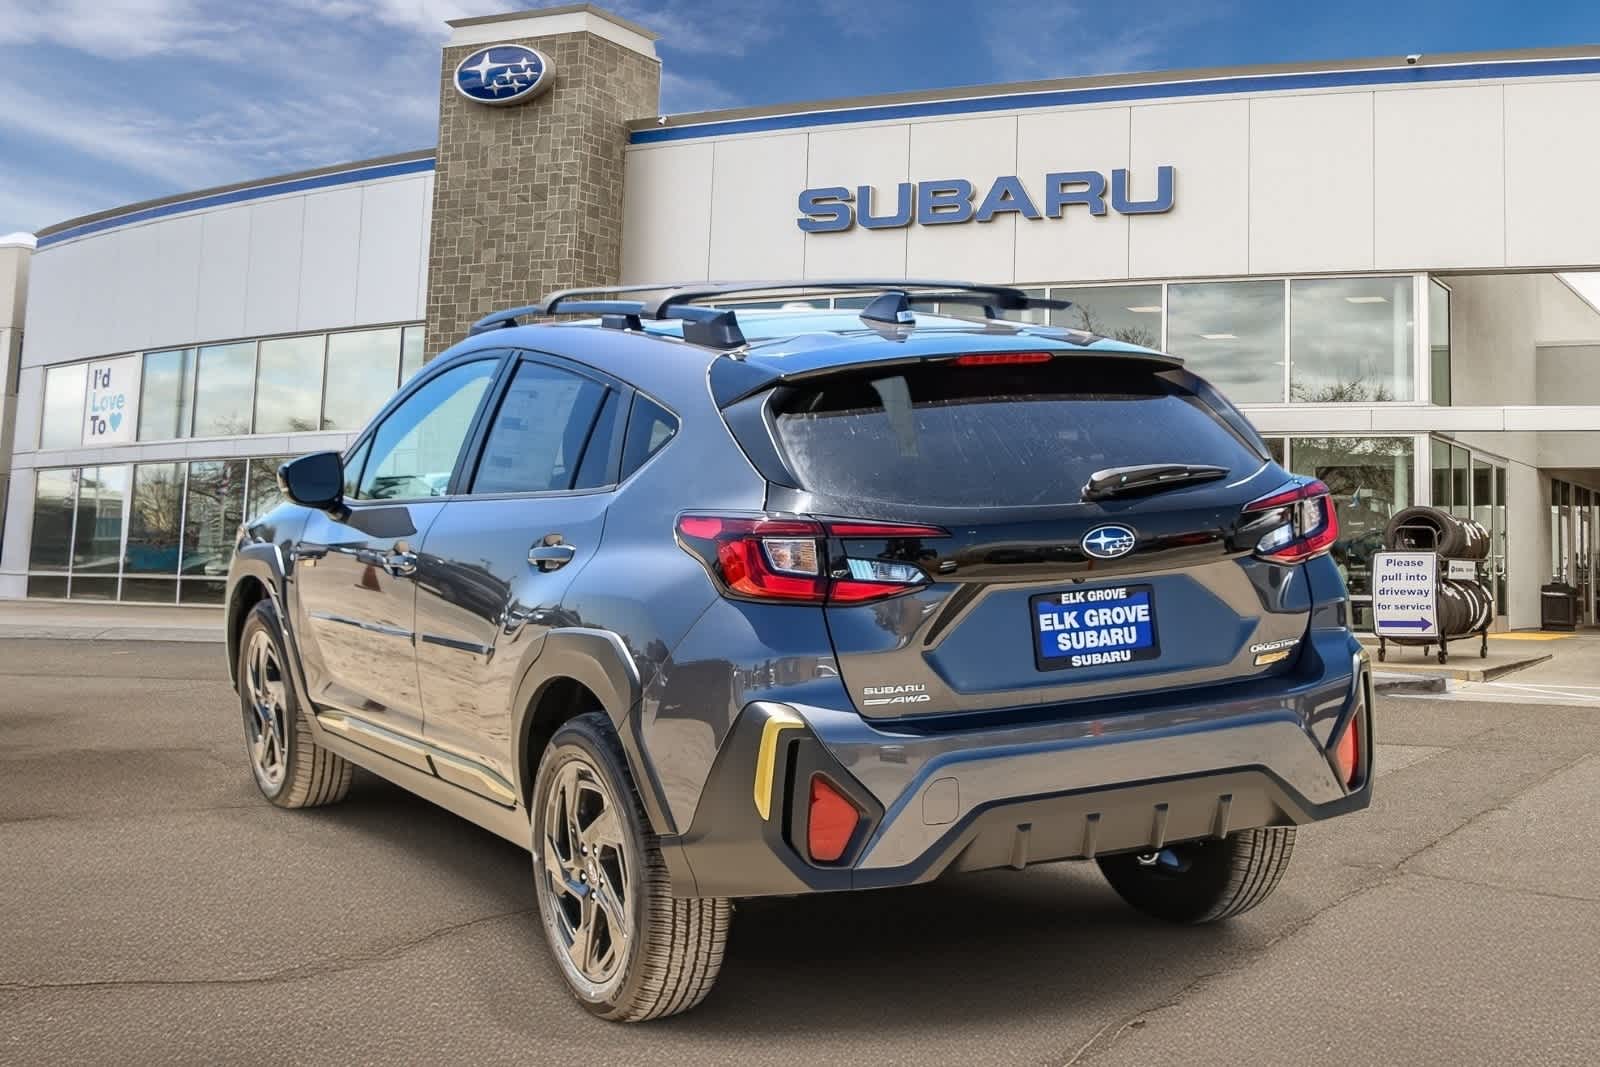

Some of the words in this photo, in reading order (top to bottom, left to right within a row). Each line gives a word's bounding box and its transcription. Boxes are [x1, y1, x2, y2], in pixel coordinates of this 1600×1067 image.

[796, 165, 1176, 235] SUBARU
[93, 368, 112, 390] I'd
[91, 391, 125, 413] Love
[90, 415, 106, 436] To
[1386, 558, 1424, 567] Please
[1381, 573, 1402, 583] pull
[1405, 573, 1428, 581] into
[1061, 591, 1086, 605] ELK
[1087, 588, 1127, 602] GROVE
[1378, 587, 1430, 598] driveway
[1039, 611, 1080, 632] ELK
[1083, 604, 1150, 627] GROVE
[1057, 626, 1137, 651] SUBARU
[1071, 649, 1132, 667] SUBARU
[863, 684, 926, 695] SUBARU
